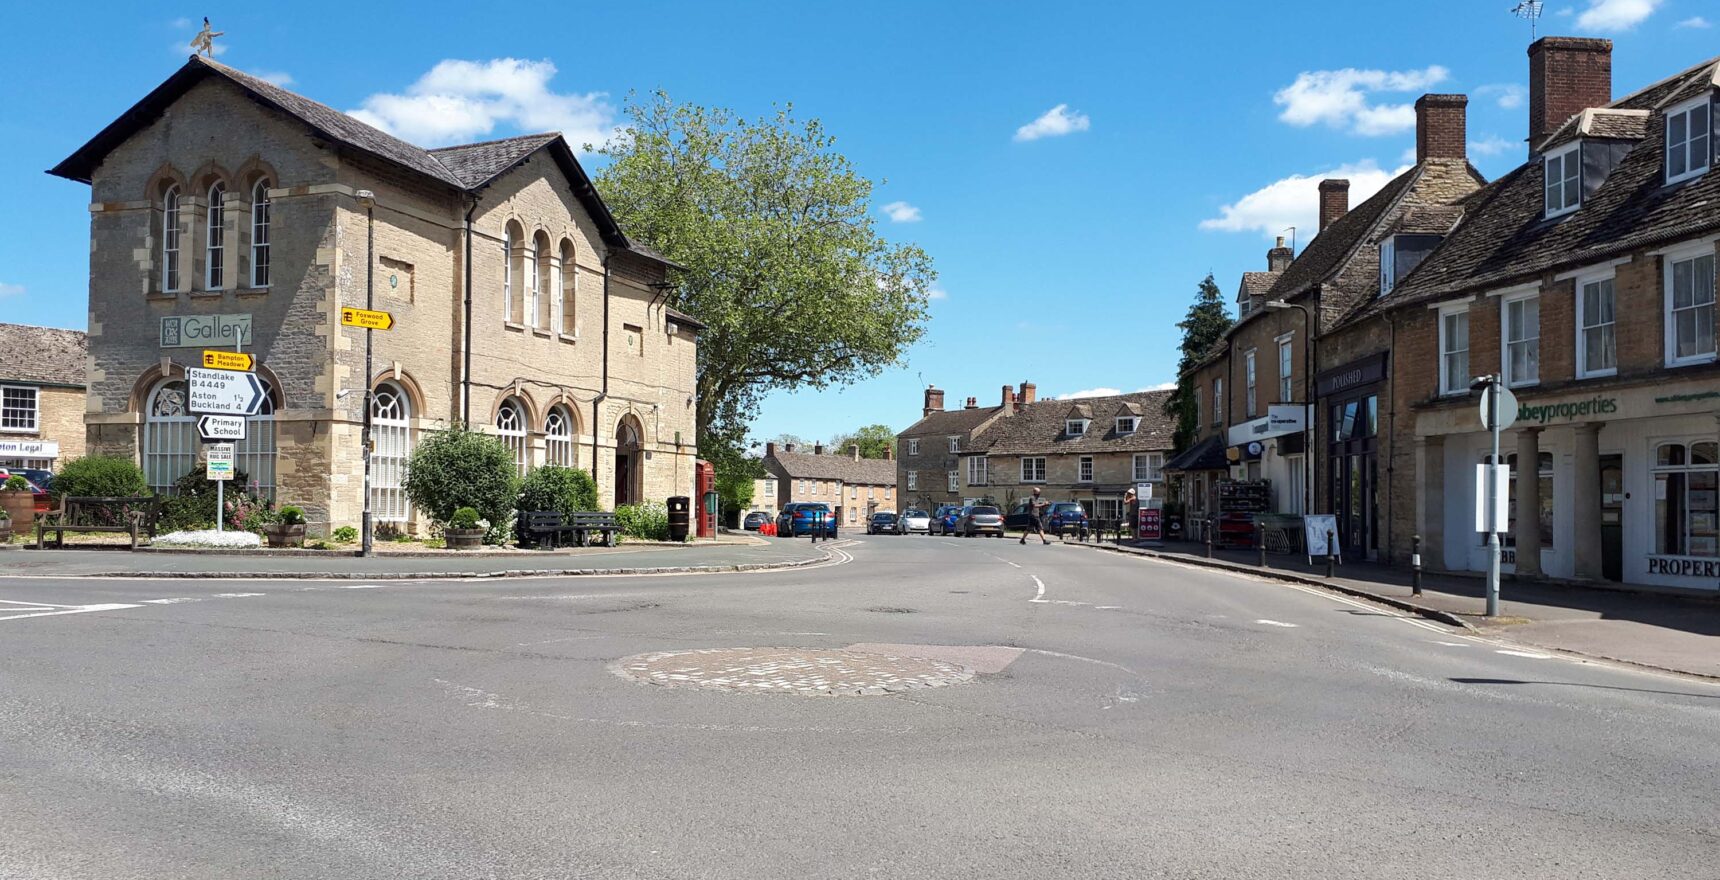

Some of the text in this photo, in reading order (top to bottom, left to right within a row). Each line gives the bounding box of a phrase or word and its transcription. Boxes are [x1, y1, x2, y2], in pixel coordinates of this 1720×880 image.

[356, 311, 384, 320] Foxwood
[360, 318, 379, 326] Grove
[184, 315, 249, 344] Gallery
[217, 353, 245, 361] Bampton
[192, 370, 235, 381] Standlake
[1332, 369, 1362, 390] POLISHED
[191, 380, 226, 390] B 4449
[191, 391, 217, 400] Aston
[191, 400, 231, 410] Buckland
[211, 418, 243, 428] Primary
[213, 427, 241, 436] School
[19, 442, 43, 454] Legal
